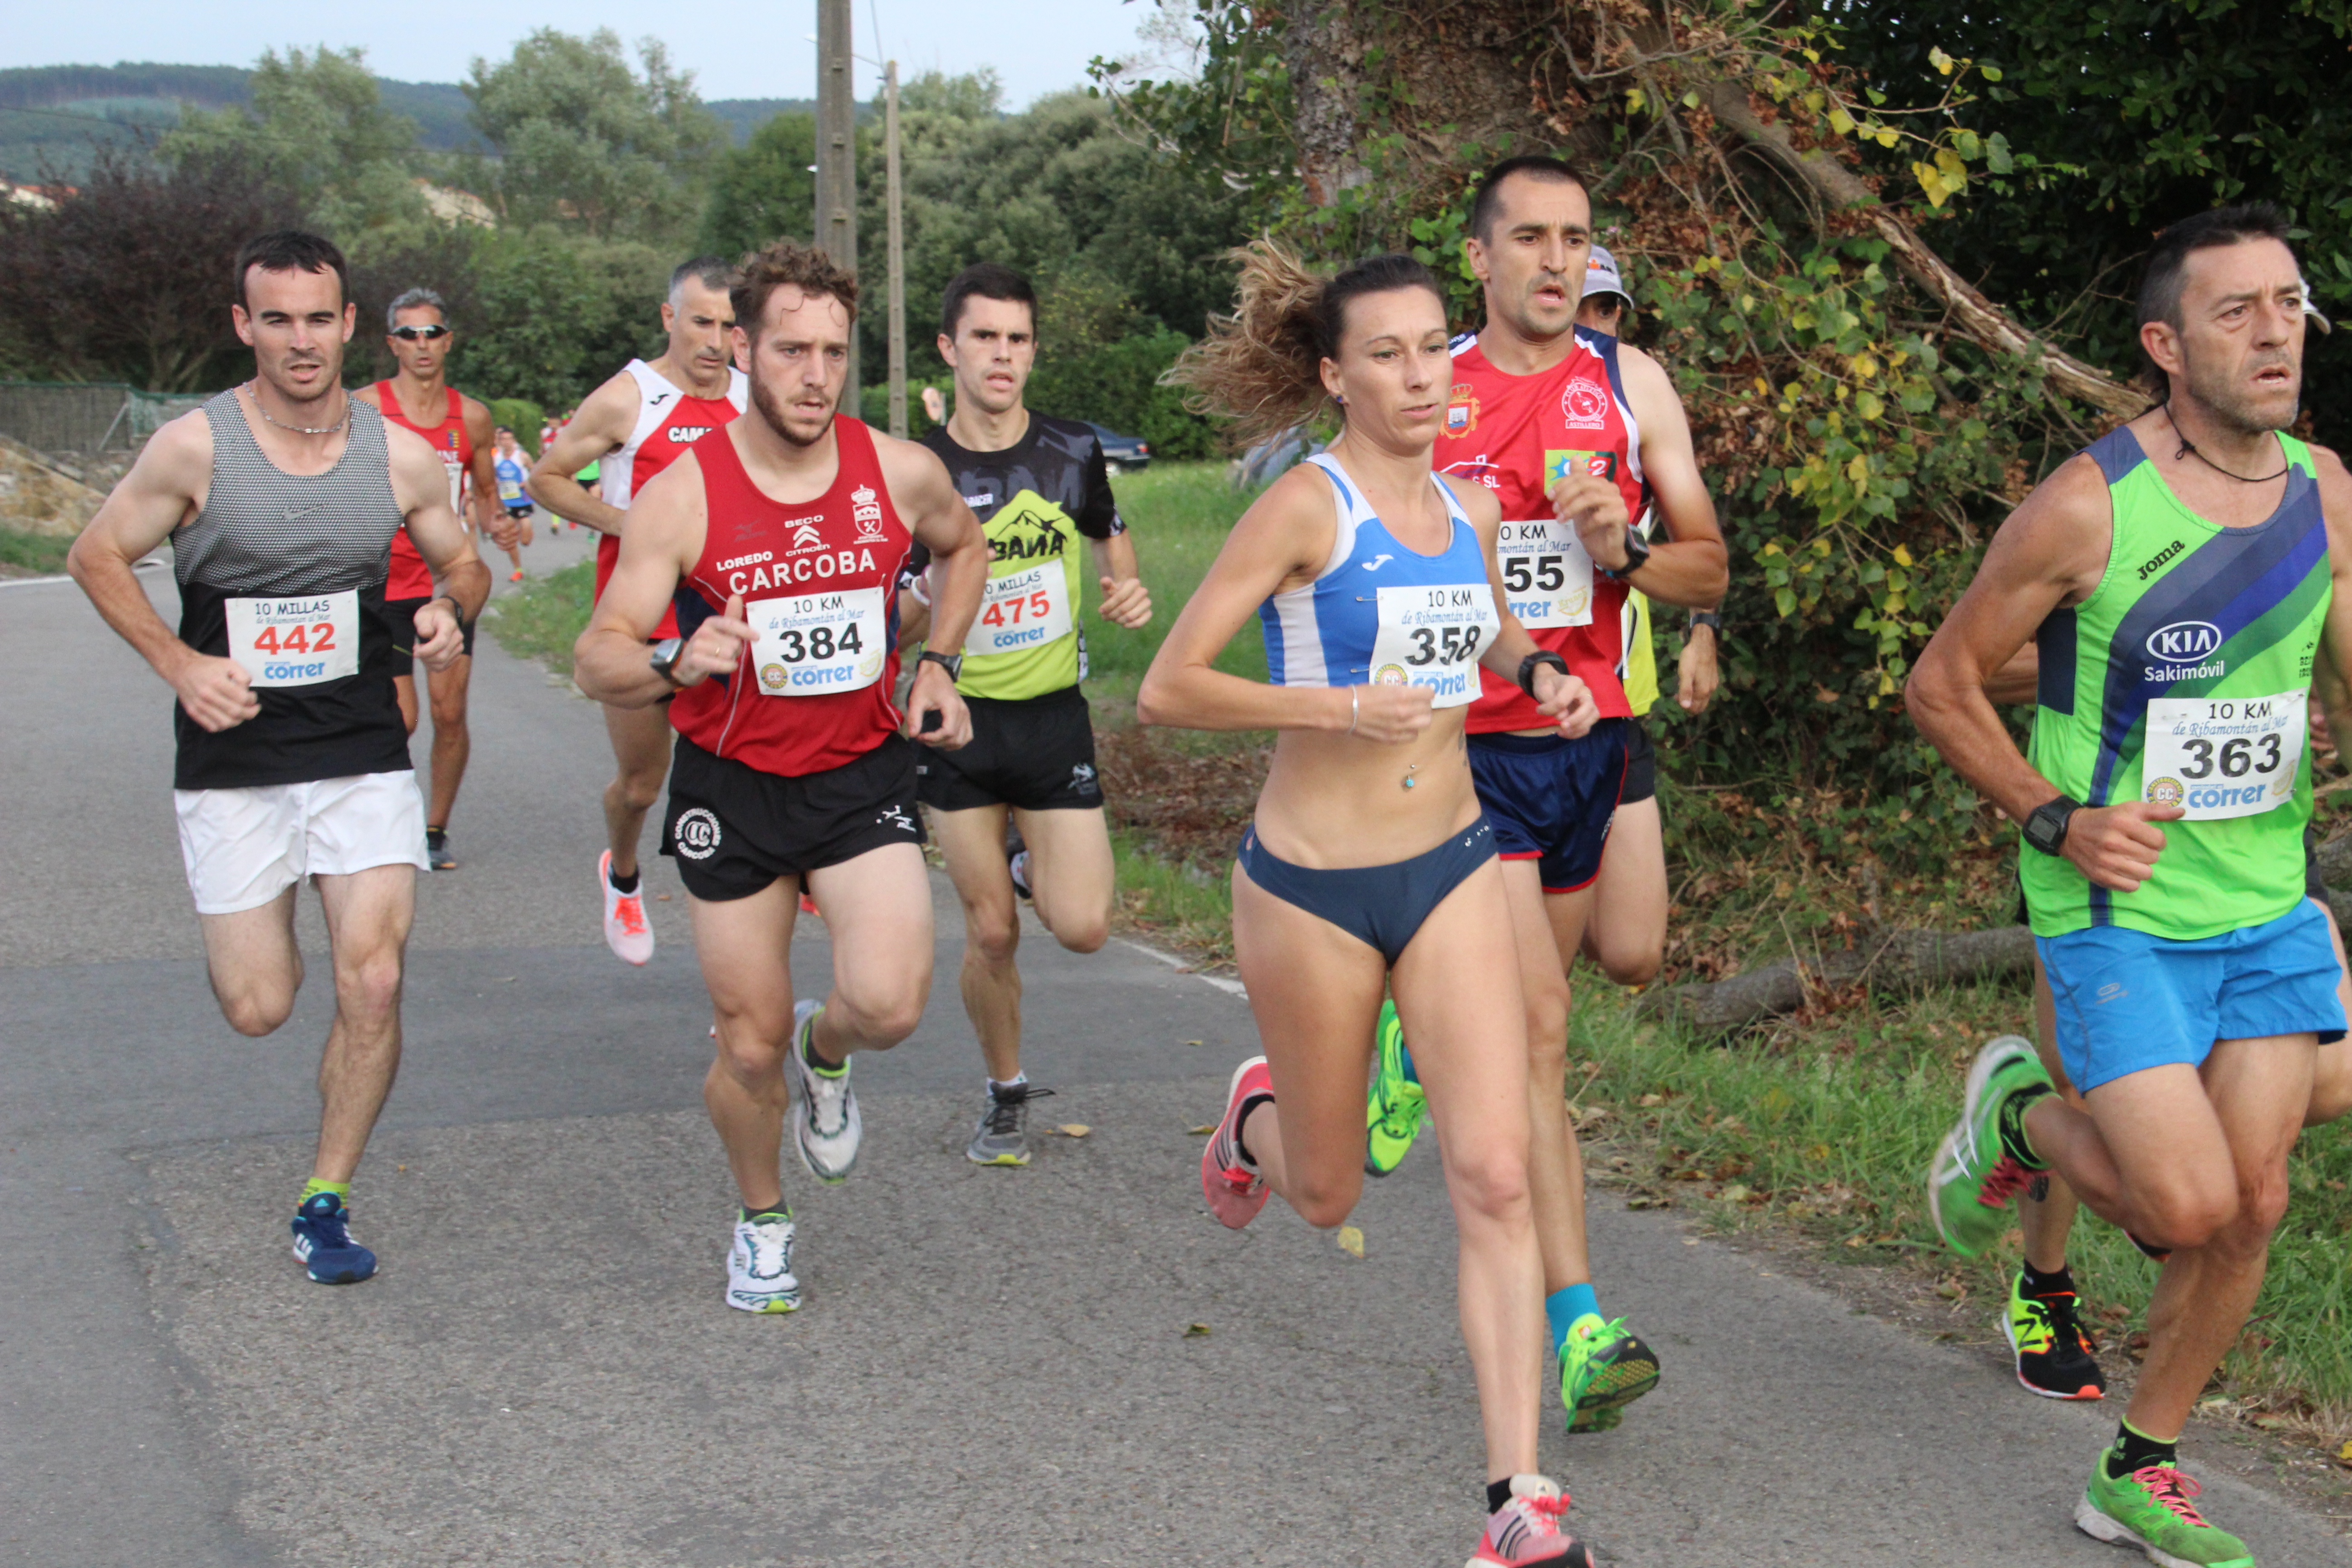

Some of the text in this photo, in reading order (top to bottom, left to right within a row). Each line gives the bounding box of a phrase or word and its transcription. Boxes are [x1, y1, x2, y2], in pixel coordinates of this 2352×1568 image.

[784, 515, 824, 528] BECO
[1500, 524, 1547, 540] 0 KM
[1537, 539, 1547, 553] al
[1549, 541, 1572, 553] Mar
[716, 551, 773, 571] LOREDO
[729, 549, 876, 595] CARCOBA
[999, 571, 1041, 592] MILLAS
[1504, 555, 1564, 593] 55
[255, 600, 330, 615] 10 MILLAS
[794, 596, 844, 613] 10 KM
[982, 590, 1051, 627] 475
[1428, 589, 1473, 607] 10 KM
[769, 617, 779, 629] de
[837, 609, 846, 621] al
[847, 609, 865, 620] Mar
[1401, 610, 1412, 625] de
[1465, 607, 1473, 622] al
[1473, 610, 1488, 622] Mar
[254, 622, 336, 655] 442
[779, 622, 863, 663] 384
[994, 626, 1045, 647] correr
[1405, 625, 1481, 666] 358
[2161, 629, 2211, 654] KIA
[265, 662, 325, 679] correr
[792, 665, 854, 686] correr
[2144, 661, 2225, 682] Sakimóvil
[2209, 701, 2272, 720] 10 KM
[2172, 721, 2185, 735] de
[2190, 721, 2259, 738] Ribamontán
[2179, 733, 2281, 779] 363
[2156, 788, 2174, 800] CC
[2188, 784, 2266, 808] correr
[674, 808, 722, 847] CONSTRUCCIONES
[677, 842, 716, 860] CARCOBA
